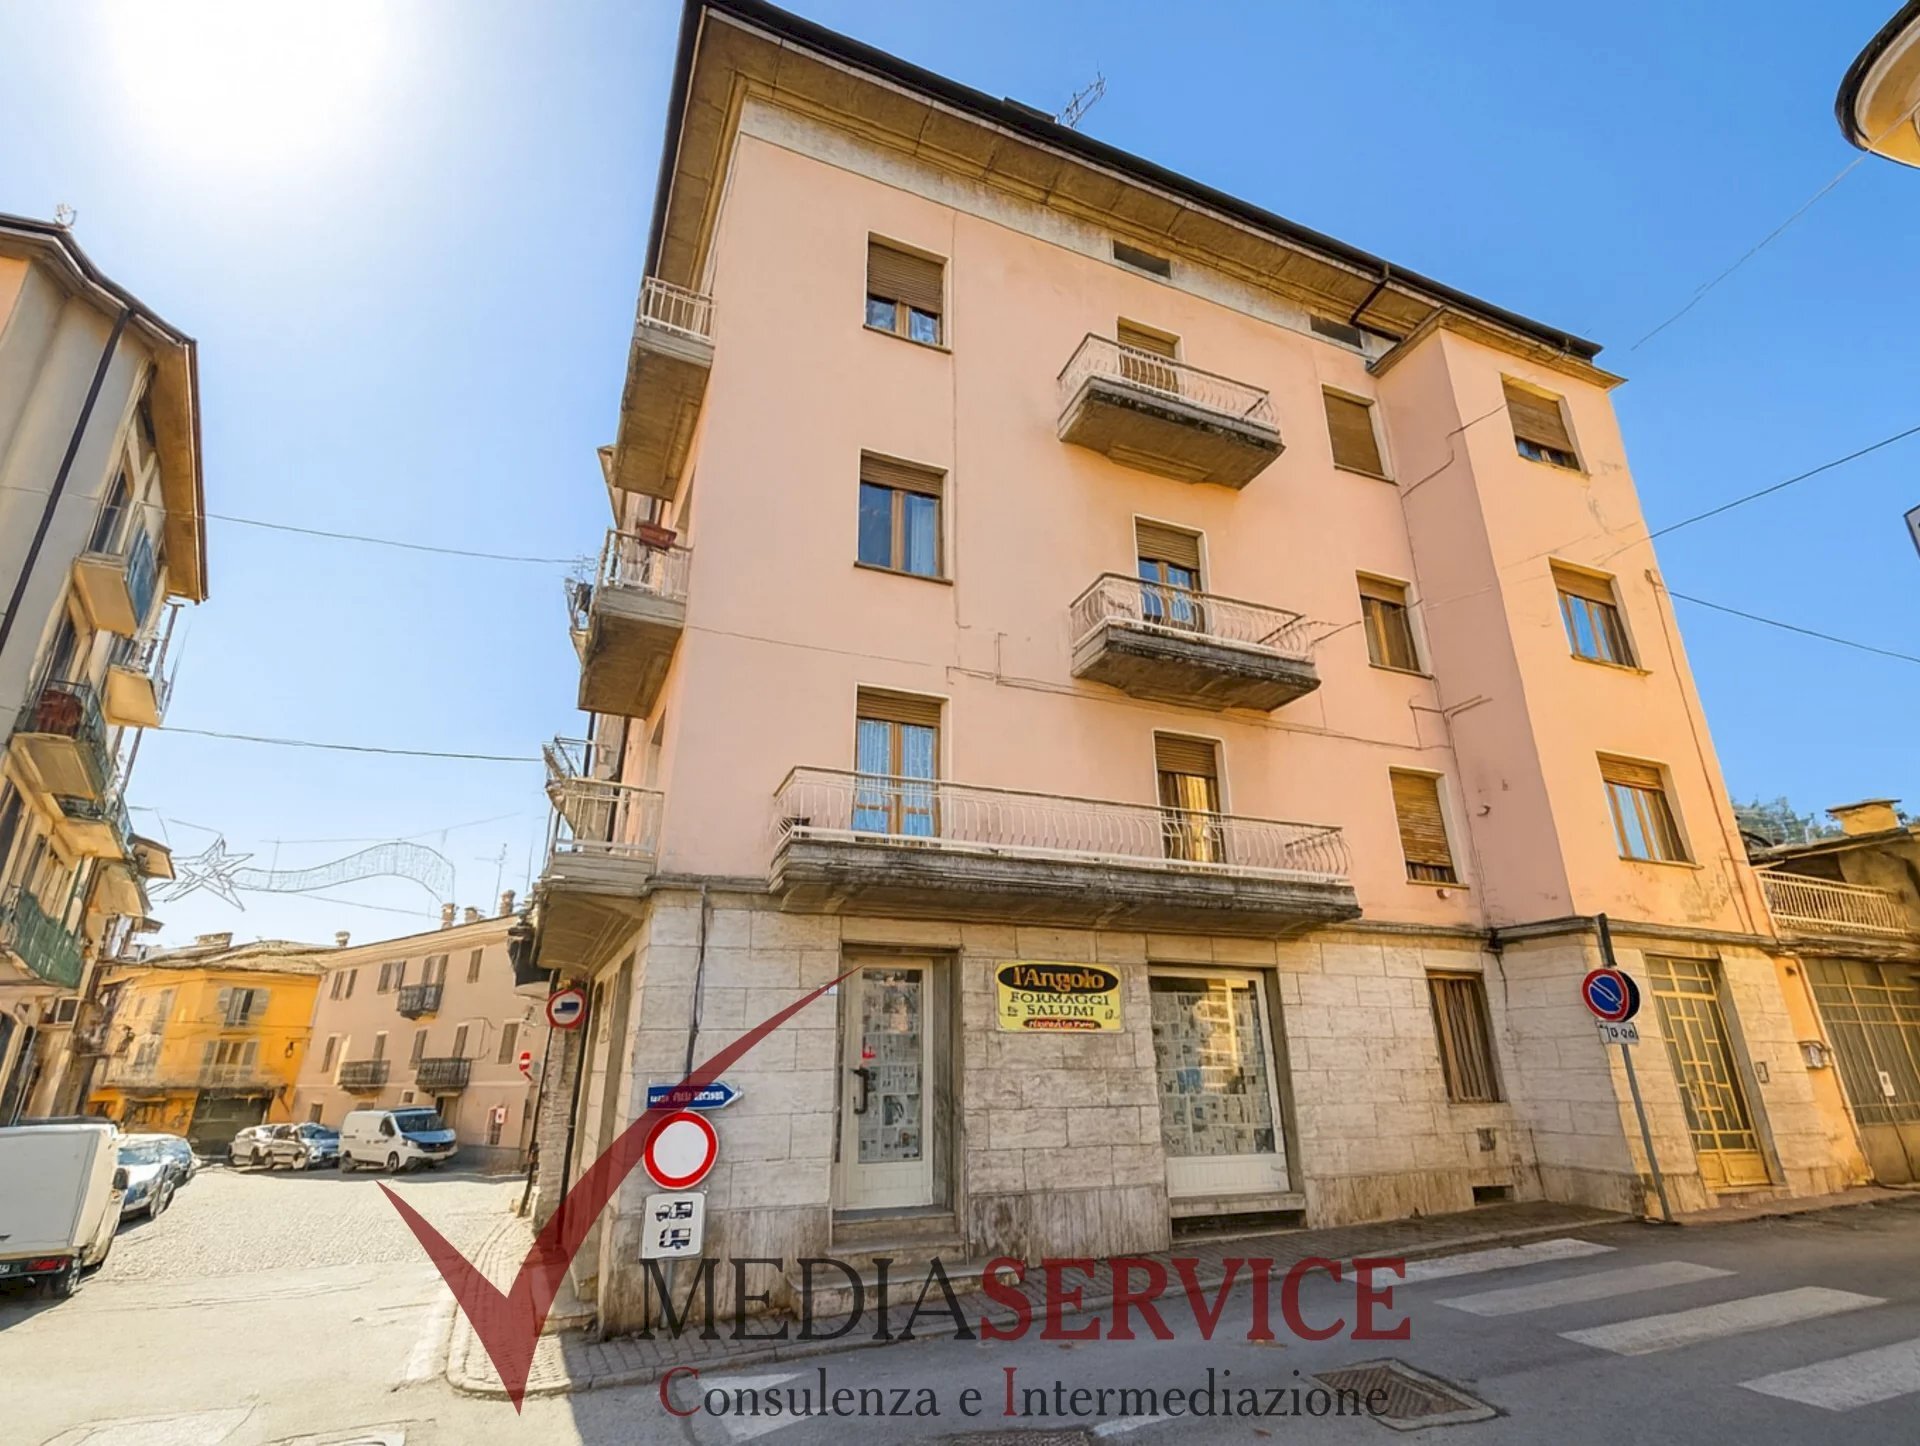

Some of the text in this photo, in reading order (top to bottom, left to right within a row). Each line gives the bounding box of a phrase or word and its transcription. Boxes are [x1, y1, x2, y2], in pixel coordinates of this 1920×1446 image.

[1013, 967, 1105, 992] l'Angolo
[1010, 991, 1110, 1005] FORMAGGI
[1027, 1005, 1095, 1017] SALUMI
